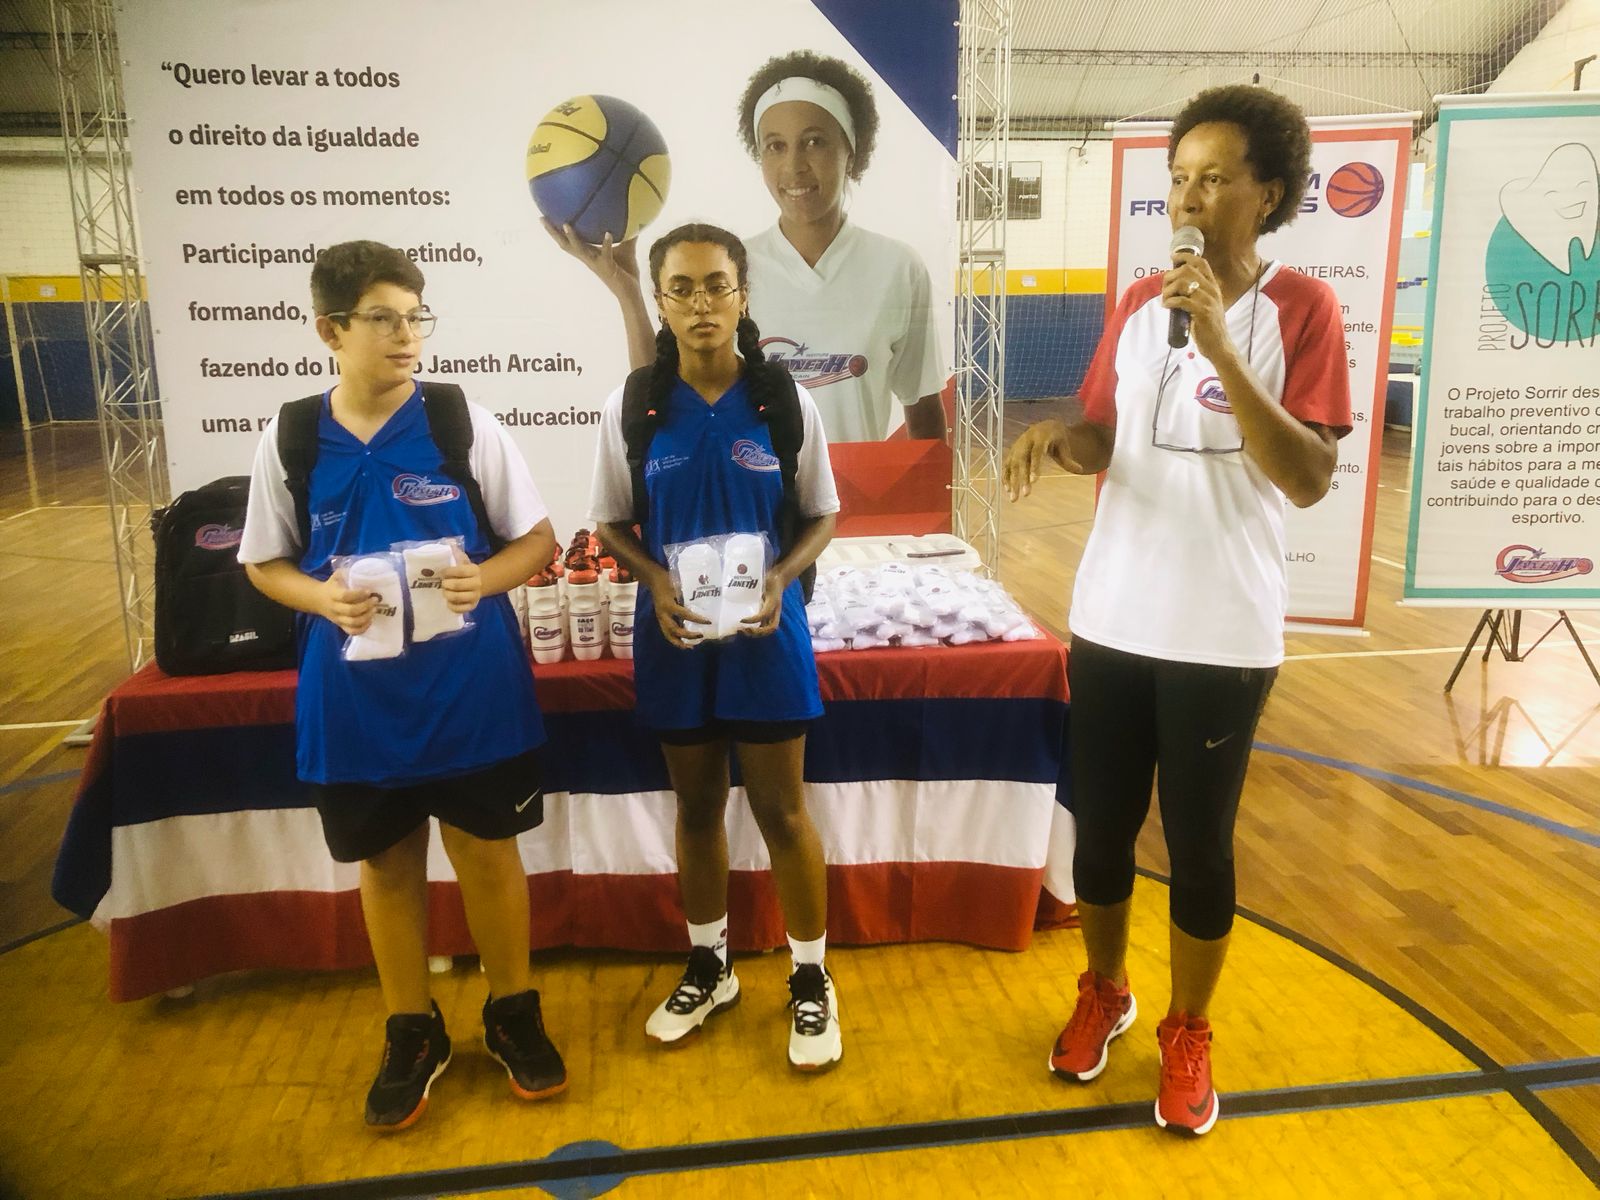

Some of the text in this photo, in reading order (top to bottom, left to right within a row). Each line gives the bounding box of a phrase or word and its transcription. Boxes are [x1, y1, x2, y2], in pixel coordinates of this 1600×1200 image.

[251, 64, 309, 86] levar
[315, 71, 329, 86] a
[334, 66, 400, 87] todos
[168, 124, 419, 152] o direito da igualdade
[175, 185, 450, 206] em todos os momentos:
[1134, 267, 1146, 279] O
[189, 301, 307, 324] formando,
[1478, 283, 1512, 350] PROJETO
[200, 357, 290, 377] fazendo
[295, 357, 322, 376] do
[427, 353, 501, 374] Janeth
[507, 352, 583, 376] Arcain,
[1447, 388, 1460, 401] O
[1466, 388, 1520, 403] Projeto
[1525, 386, 1568, 400] Sorrir
[1444, 406, 1505, 419] trabalho
[1510, 405, 1590, 420] preventivo
[202, 416, 252, 432] uma
[1450, 424, 1494, 437] bucal,
[1500, 422, 1582, 436] orientando
[1440, 443, 1490, 457] jovens
[1495, 441, 1538, 454] sobre
[1543, 444, 1552, 453] a
[1437, 460, 1463, 472] tais
[1468, 459, 1523, 471] hábitos
[1528, 461, 1562, 473] para
[1567, 461, 1576, 471] a
[1450, 476, 1496, 489] saúde
[1501, 480, 1510, 489] e
[1515, 475, 1590, 491] qualidade
[1427, 494, 1518, 507] contribuindo
[1523, 496, 1557, 508] para
[1562, 496, 1572, 506] o
[1511, 511, 1585, 526] esportivo.
